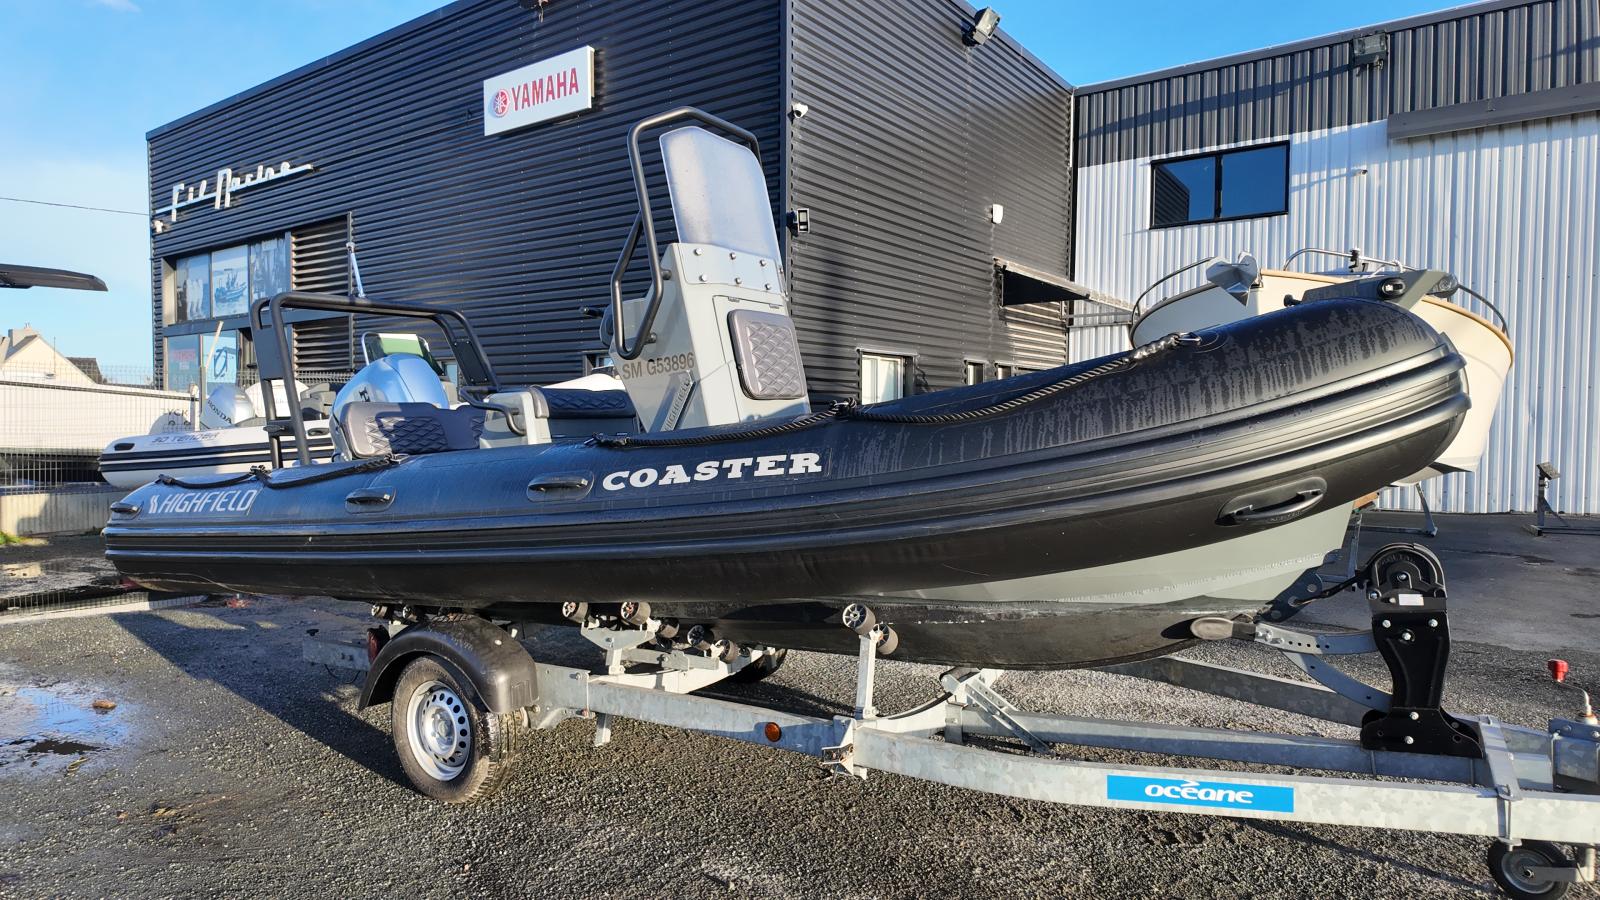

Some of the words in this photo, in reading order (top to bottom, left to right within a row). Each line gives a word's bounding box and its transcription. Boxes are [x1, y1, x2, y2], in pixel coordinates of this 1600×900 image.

[511, 67, 579, 111] YAMAHA
[621, 362, 643, 380] SM
[646, 351, 695, 376] G53896
[207, 400, 232, 424] HONDA
[602, 452, 822, 491] COASTER
[158, 489, 257, 514] HIGHFIELD
